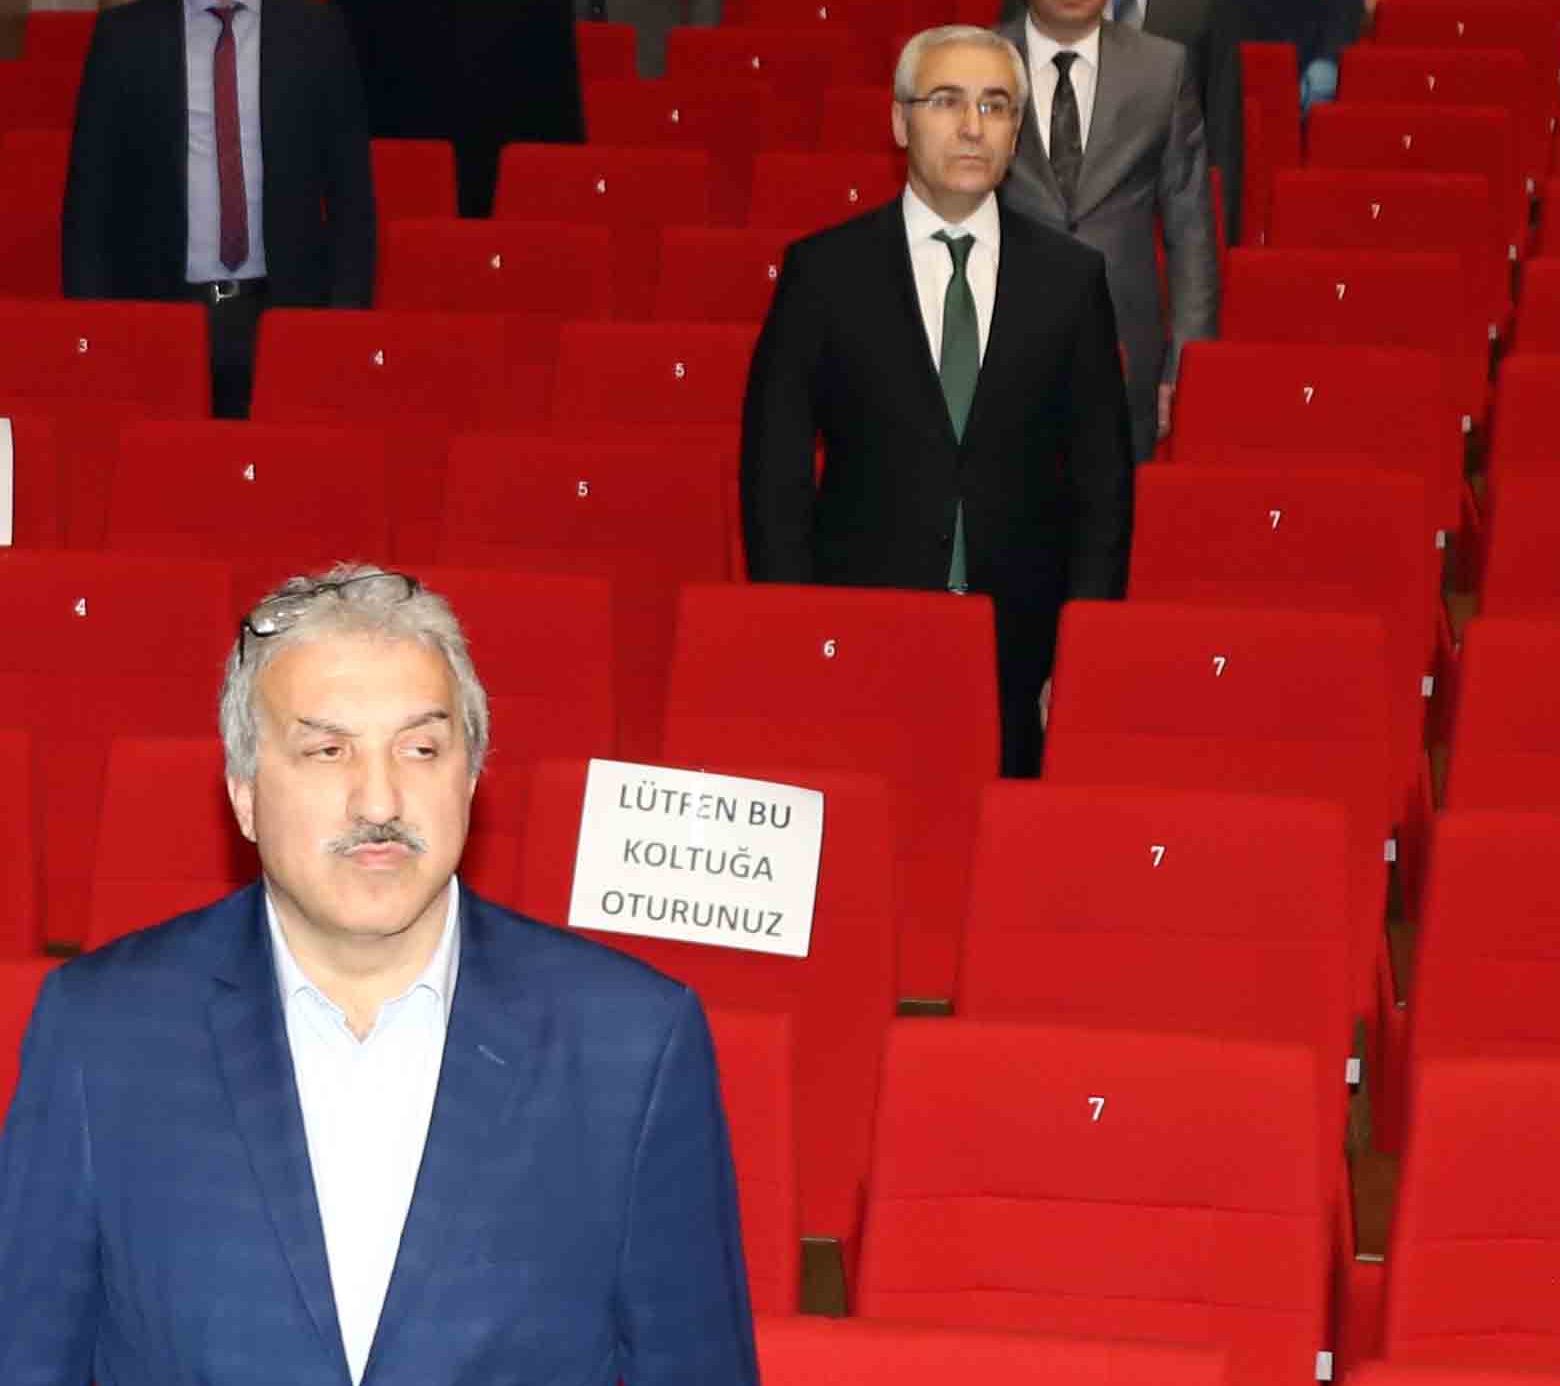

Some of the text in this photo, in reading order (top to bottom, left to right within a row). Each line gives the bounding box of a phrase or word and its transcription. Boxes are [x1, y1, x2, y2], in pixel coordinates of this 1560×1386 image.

[79, 338, 88, 353] 3
[374, 350, 384, 366] 4
[674, 362, 685, 378] 5
[1303, 386, 1314, 403] 7
[243, 464, 255, 481] 4
[577, 480, 588, 497] 5
[1269, 510, 1281, 528] 7
[74, 598, 87, 616] 4
[823, 639, 835, 658] 6
[1213, 656, 1226, 676] 7
[748, 800, 792, 829] BU
[623, 839, 774, 881] KOLTUĞA
[1150, 845, 1165, 867] 7
[601, 890, 784, 937] OTURUNUZ
[1088, 1097, 1105, 1121] 7
